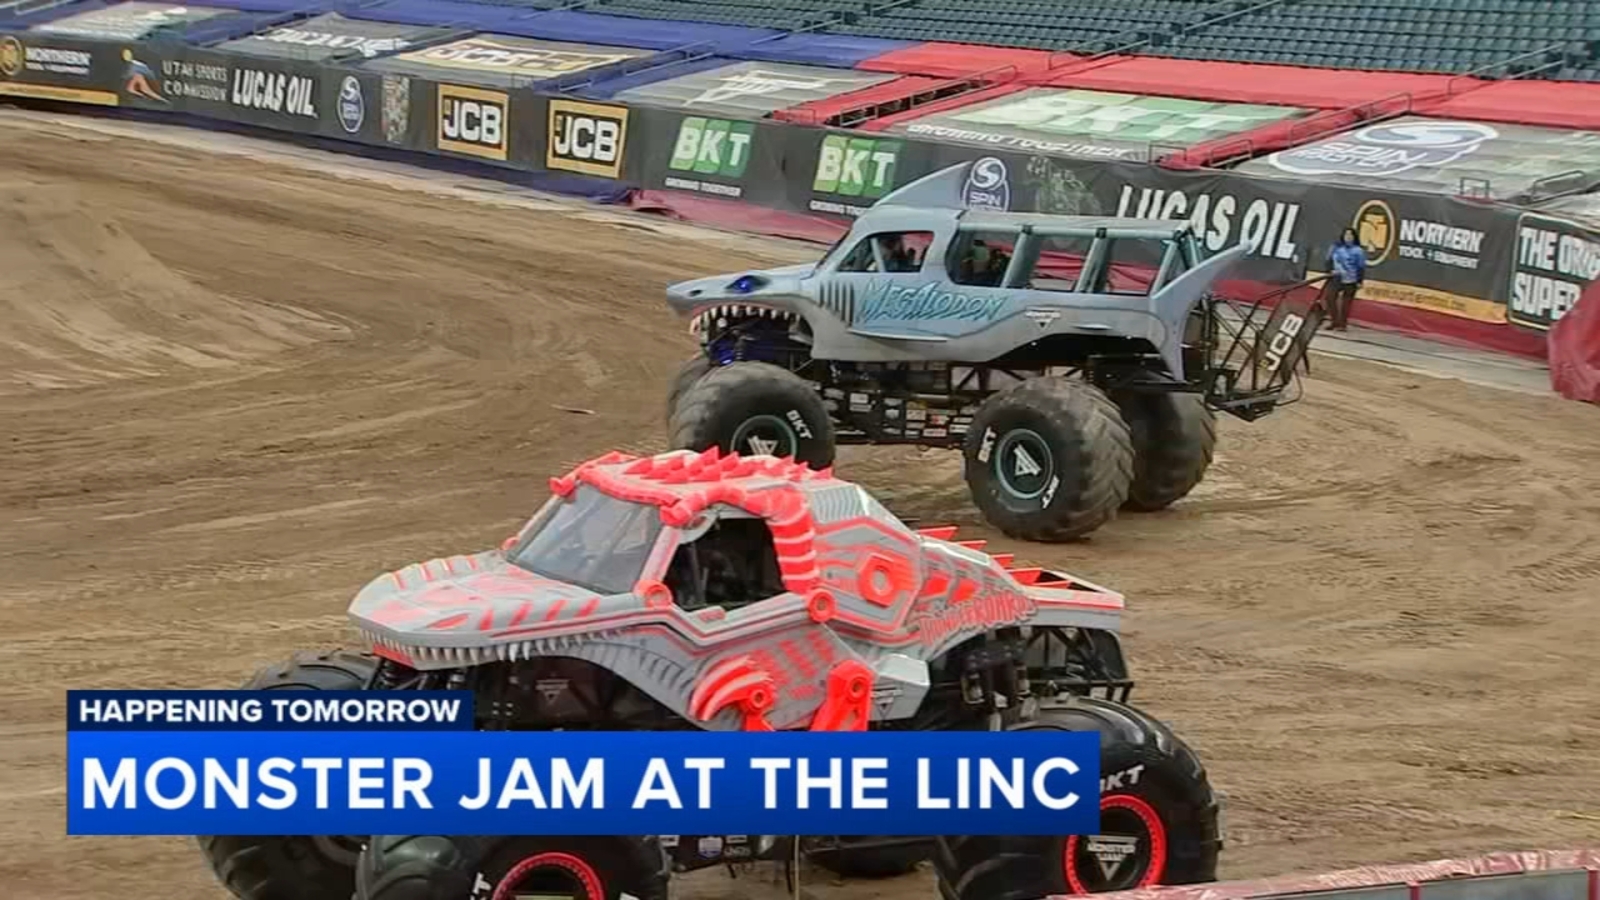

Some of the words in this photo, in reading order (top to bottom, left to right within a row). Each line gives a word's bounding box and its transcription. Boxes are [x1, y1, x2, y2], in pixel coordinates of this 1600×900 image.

[232, 68, 286, 112] LUCAS
[443, 101, 501, 144] JCB
[554, 115, 619, 163] JCB
[675, 126, 750, 166] BKT
[815, 146, 895, 187] BKT
[1116, 185, 1236, 251] LUCAS
[1400, 219, 1485, 253] NORTHERN
[1519, 227, 1559, 270] THE
[856, 277, 1010, 323] MEGALODON
[1265, 313, 1304, 371] JCB
[786, 409, 813, 439] BKT
[978, 426, 997, 463] BKT
